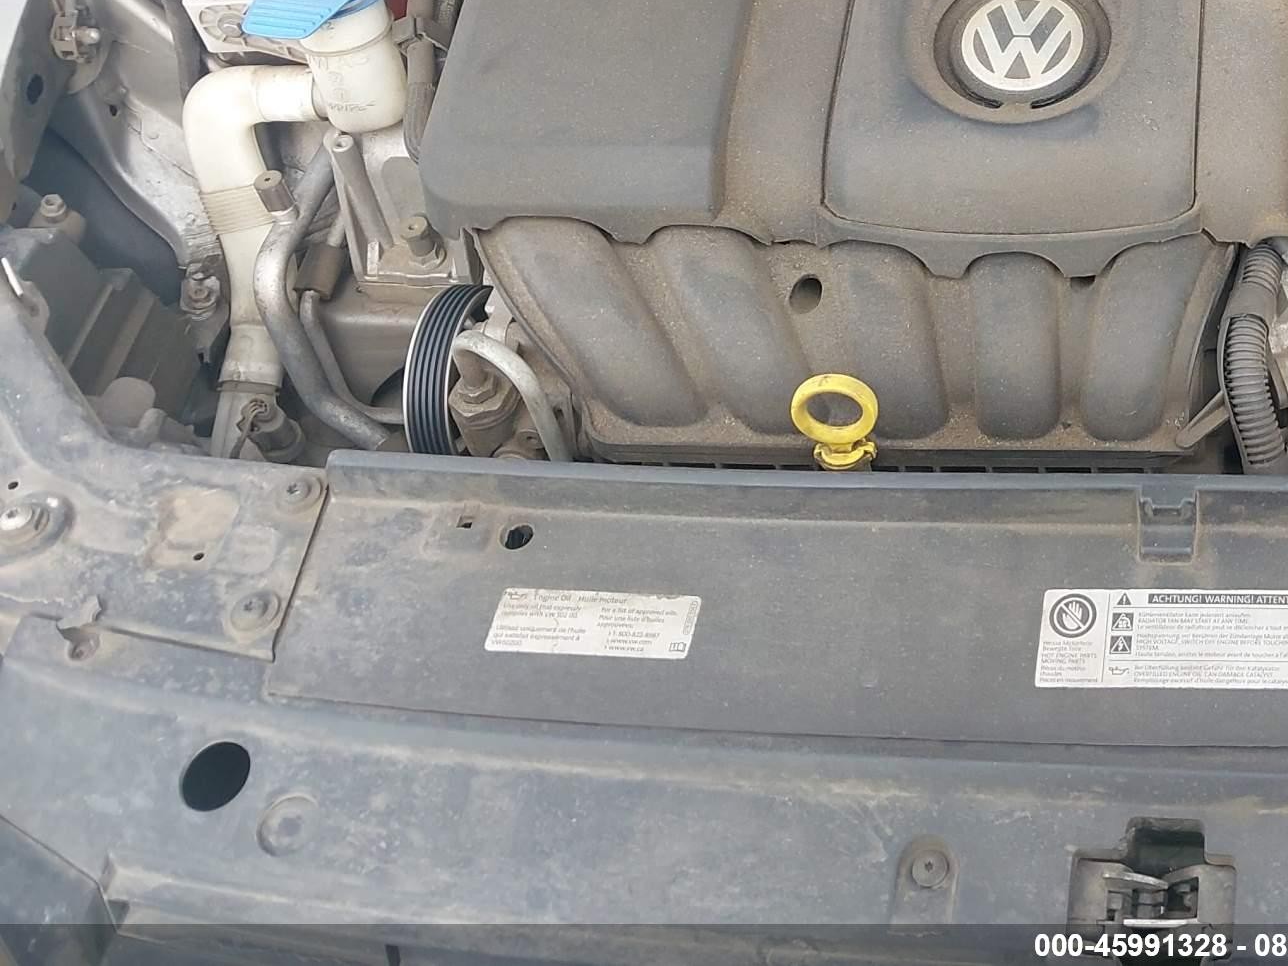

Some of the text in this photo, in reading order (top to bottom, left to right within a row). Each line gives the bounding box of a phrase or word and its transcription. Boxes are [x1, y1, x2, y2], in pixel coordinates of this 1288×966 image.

[560, 594, 572, 602] Oil
[1152, 595, 1202, 604] ACHTUNG!
[1205, 595, 1254, 604] WARNING!
